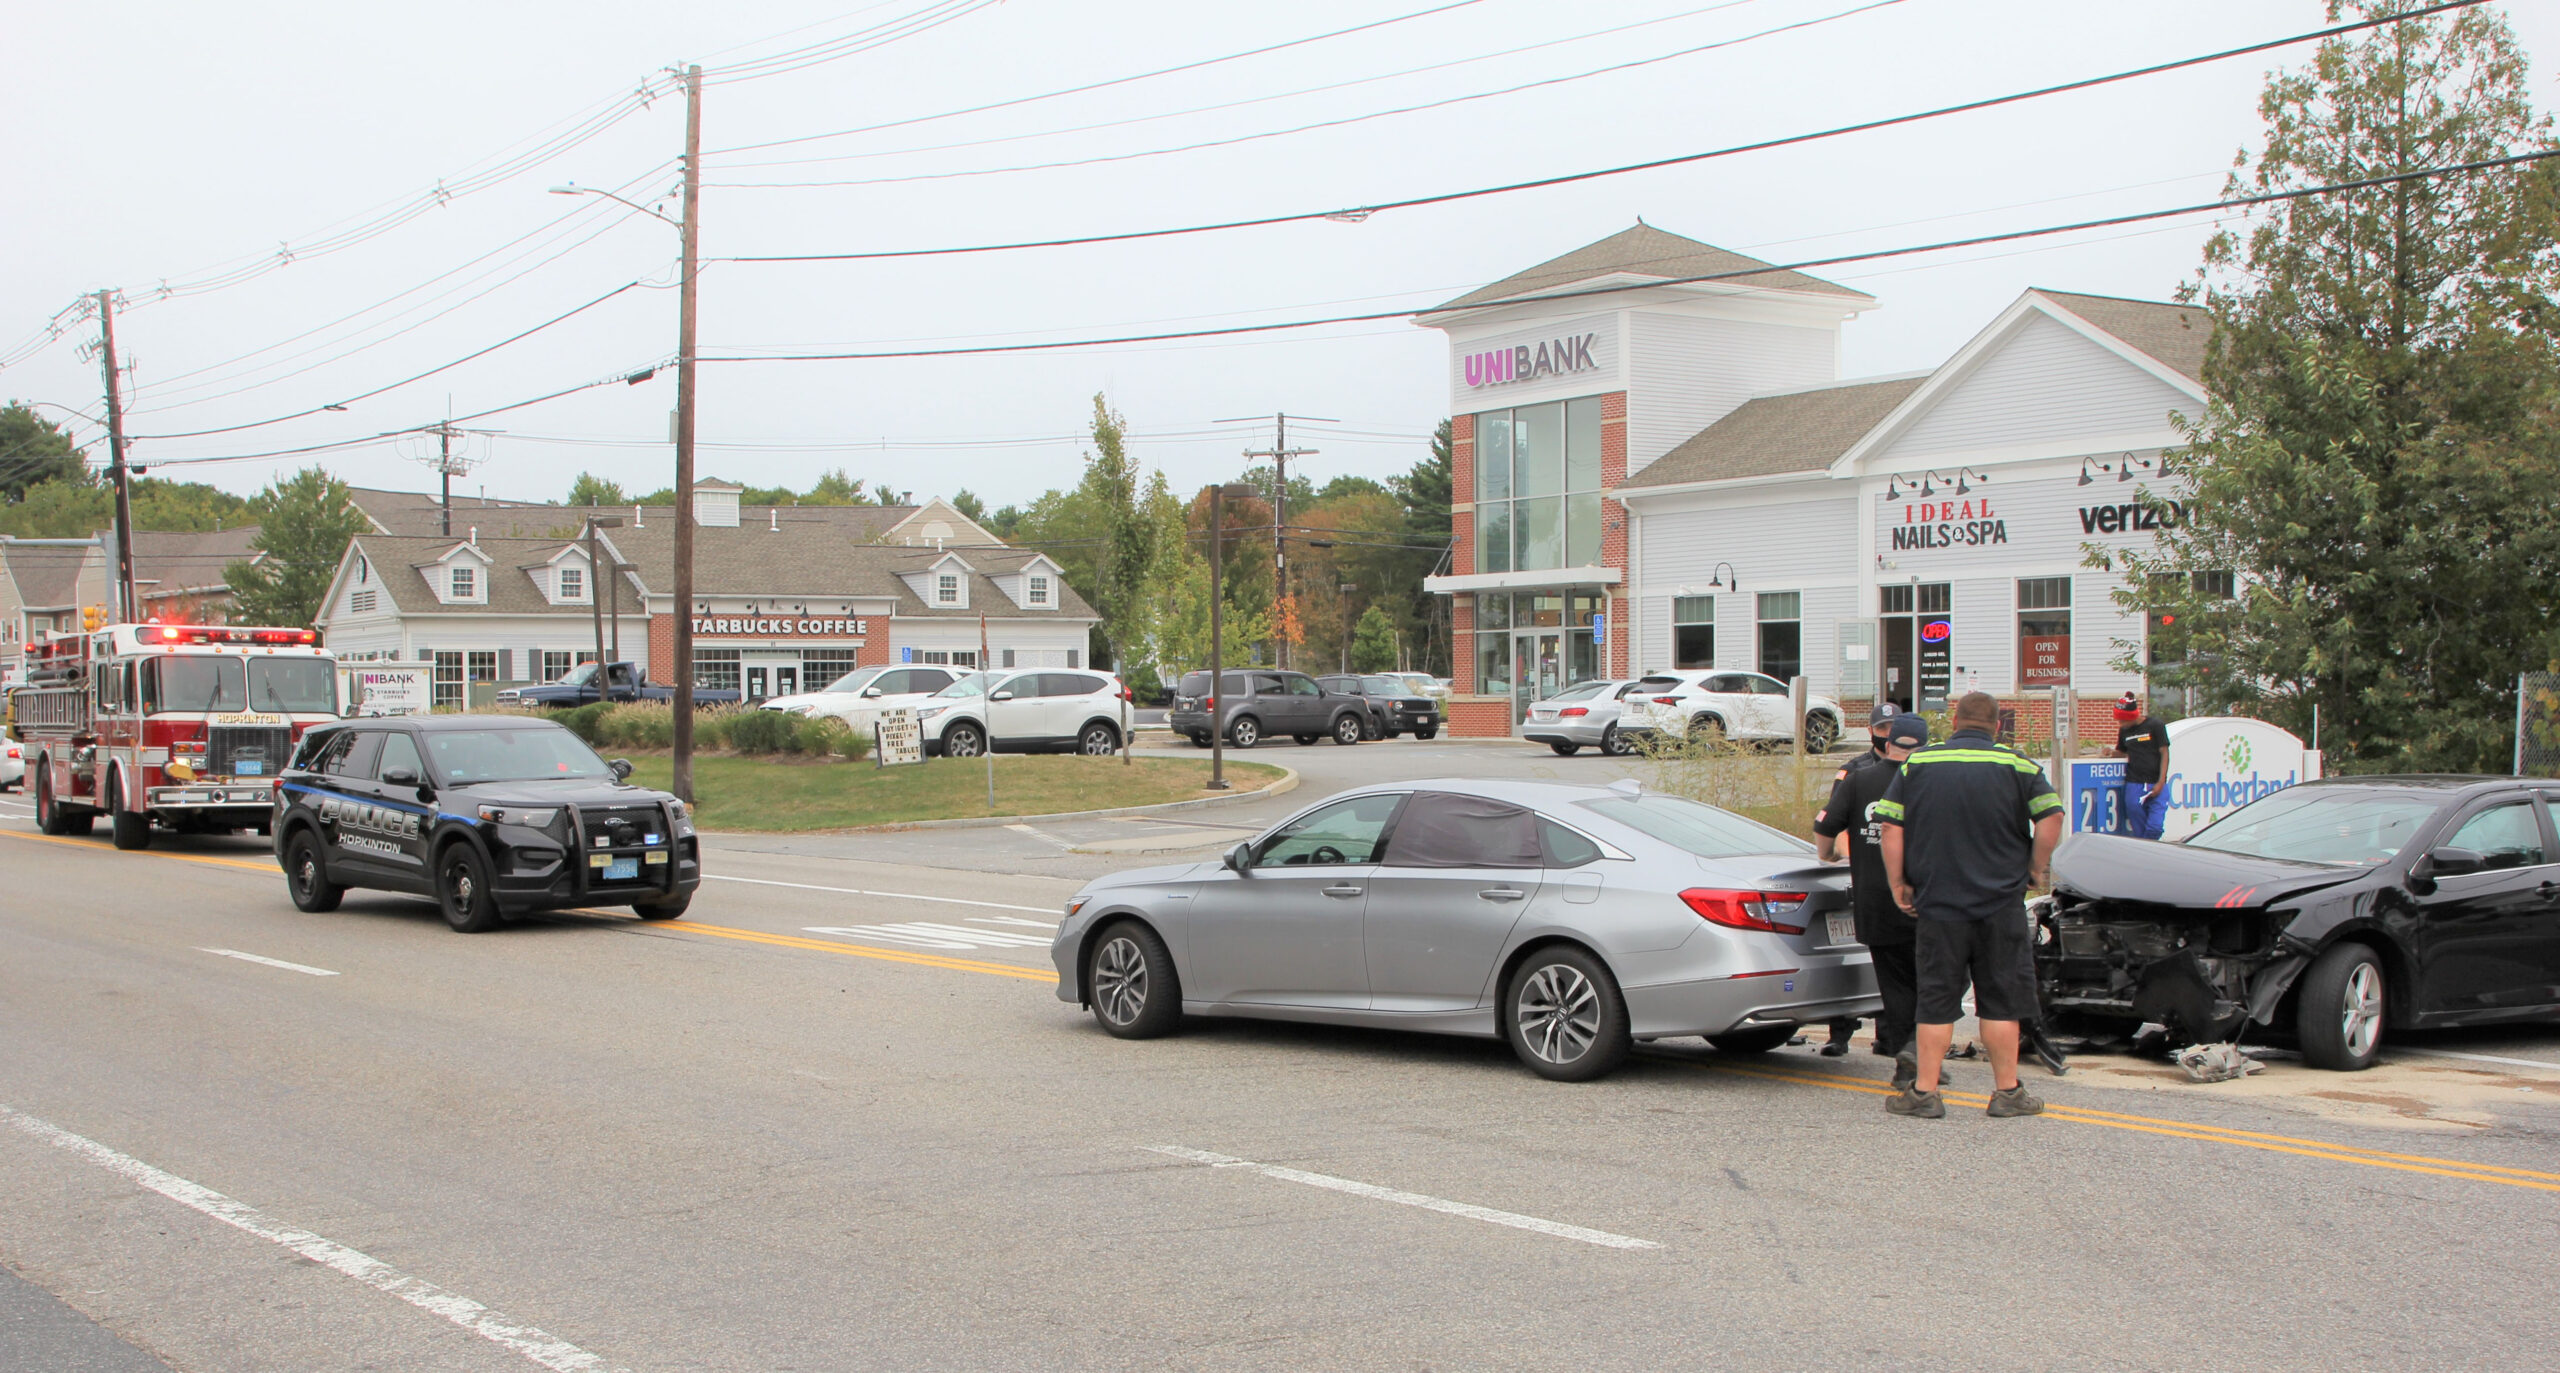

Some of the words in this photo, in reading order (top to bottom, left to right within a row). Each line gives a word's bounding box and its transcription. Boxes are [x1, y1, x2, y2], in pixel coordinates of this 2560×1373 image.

[1465, 332, 1599, 388] UNIBANK
[1905, 499, 1994, 523] IDEAL
[1892, 523, 1951, 550] NAILS
[1966, 519, 2007, 546] SPA
[692, 619, 793, 634] TARBUCKS
[797, 620, 867, 634] COFFEE
[1923, 623, 1950, 639] OPEN
[2035, 642, 2059, 652] OPEN
[2038, 655, 2056, 664] FOR
[365, 674, 414, 684] NIBANK
[2026, 668, 2069, 677] BUSINESS
[217, 714, 280, 724] HOPKINTON
[2090, 764, 2127, 778] REGUL
[257, 792, 266, 801] 2
[2168, 770, 2295, 810] Cumberland
[2081, 789, 2133, 832] 2.3
[320, 798, 420, 840] POLICE
[339, 832, 400, 854] HOPKINTON
